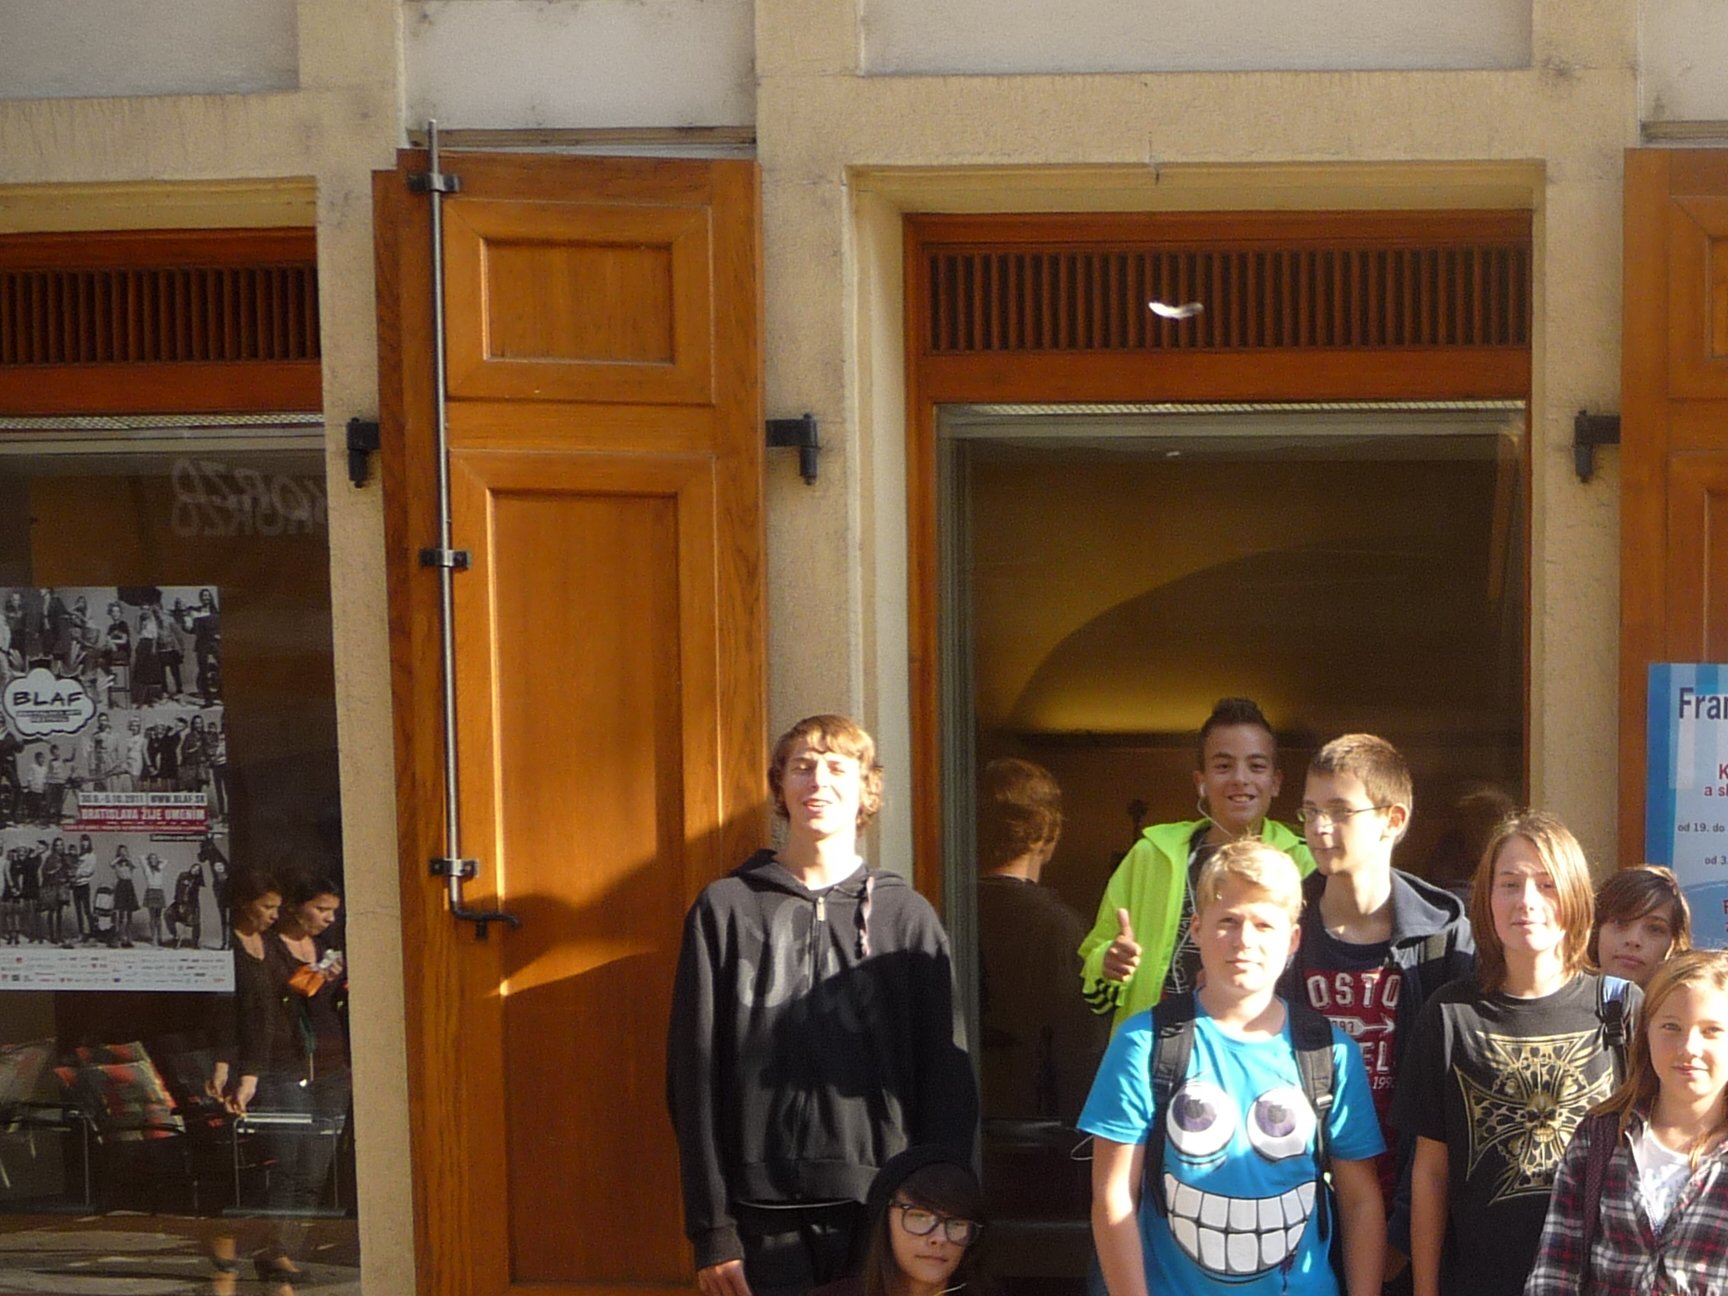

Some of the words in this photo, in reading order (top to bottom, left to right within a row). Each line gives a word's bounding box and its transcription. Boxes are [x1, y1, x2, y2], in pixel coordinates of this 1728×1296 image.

[13, 691, 84, 707] BLAF
[1704, 786, 1713, 796] a
[1678, 823, 1690, 833] od
[1693, 823, 1709, 833] 19.
[1713, 823, 1725, 833] do
[1704, 856, 1717, 865] od
[1720, 856, 1728, 865] 3.
